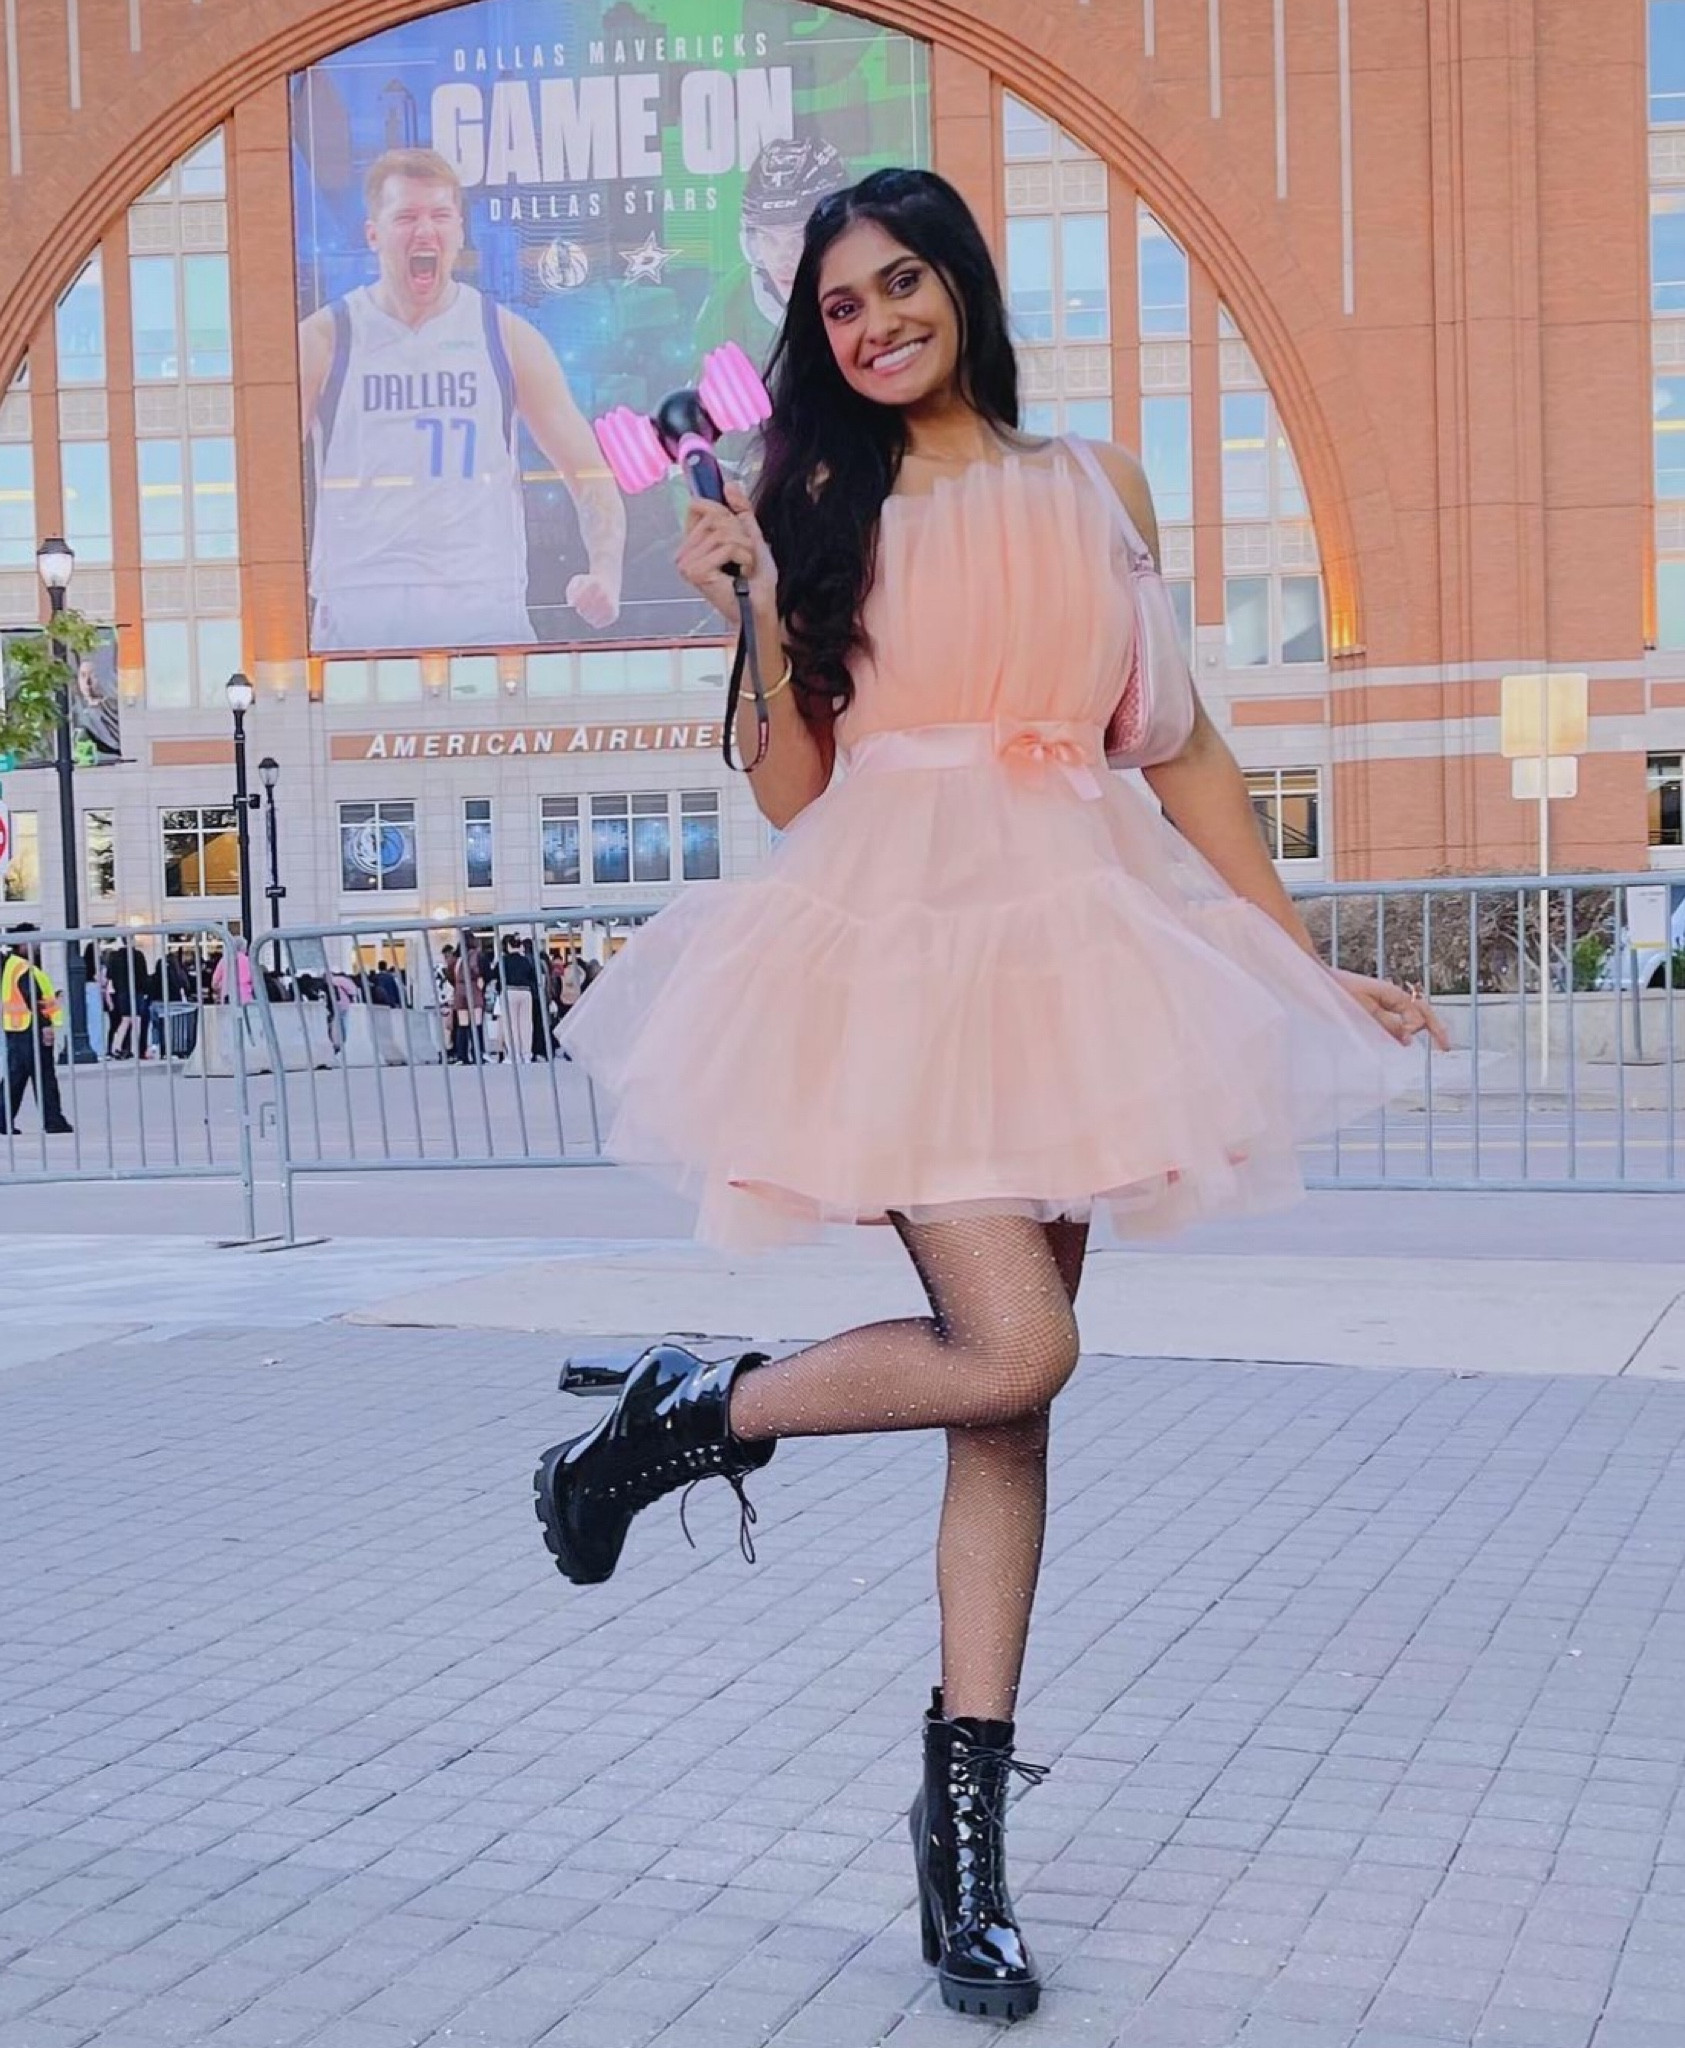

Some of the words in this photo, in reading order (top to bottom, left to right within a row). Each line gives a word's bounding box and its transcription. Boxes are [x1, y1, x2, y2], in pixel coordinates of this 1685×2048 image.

[454, 43, 565, 72] DALLAS
[589, 32, 768, 64] MAVERICKS
[431, 73, 663, 188] GAME
[681, 66, 795, 175] ON
[489, 192, 601, 222] DALLAS
[624, 187, 718, 215] STARS
[363, 371, 478, 412] DALLAS
[414, 418, 477, 478] 77
[366, 731, 554, 759] AMERICAN
